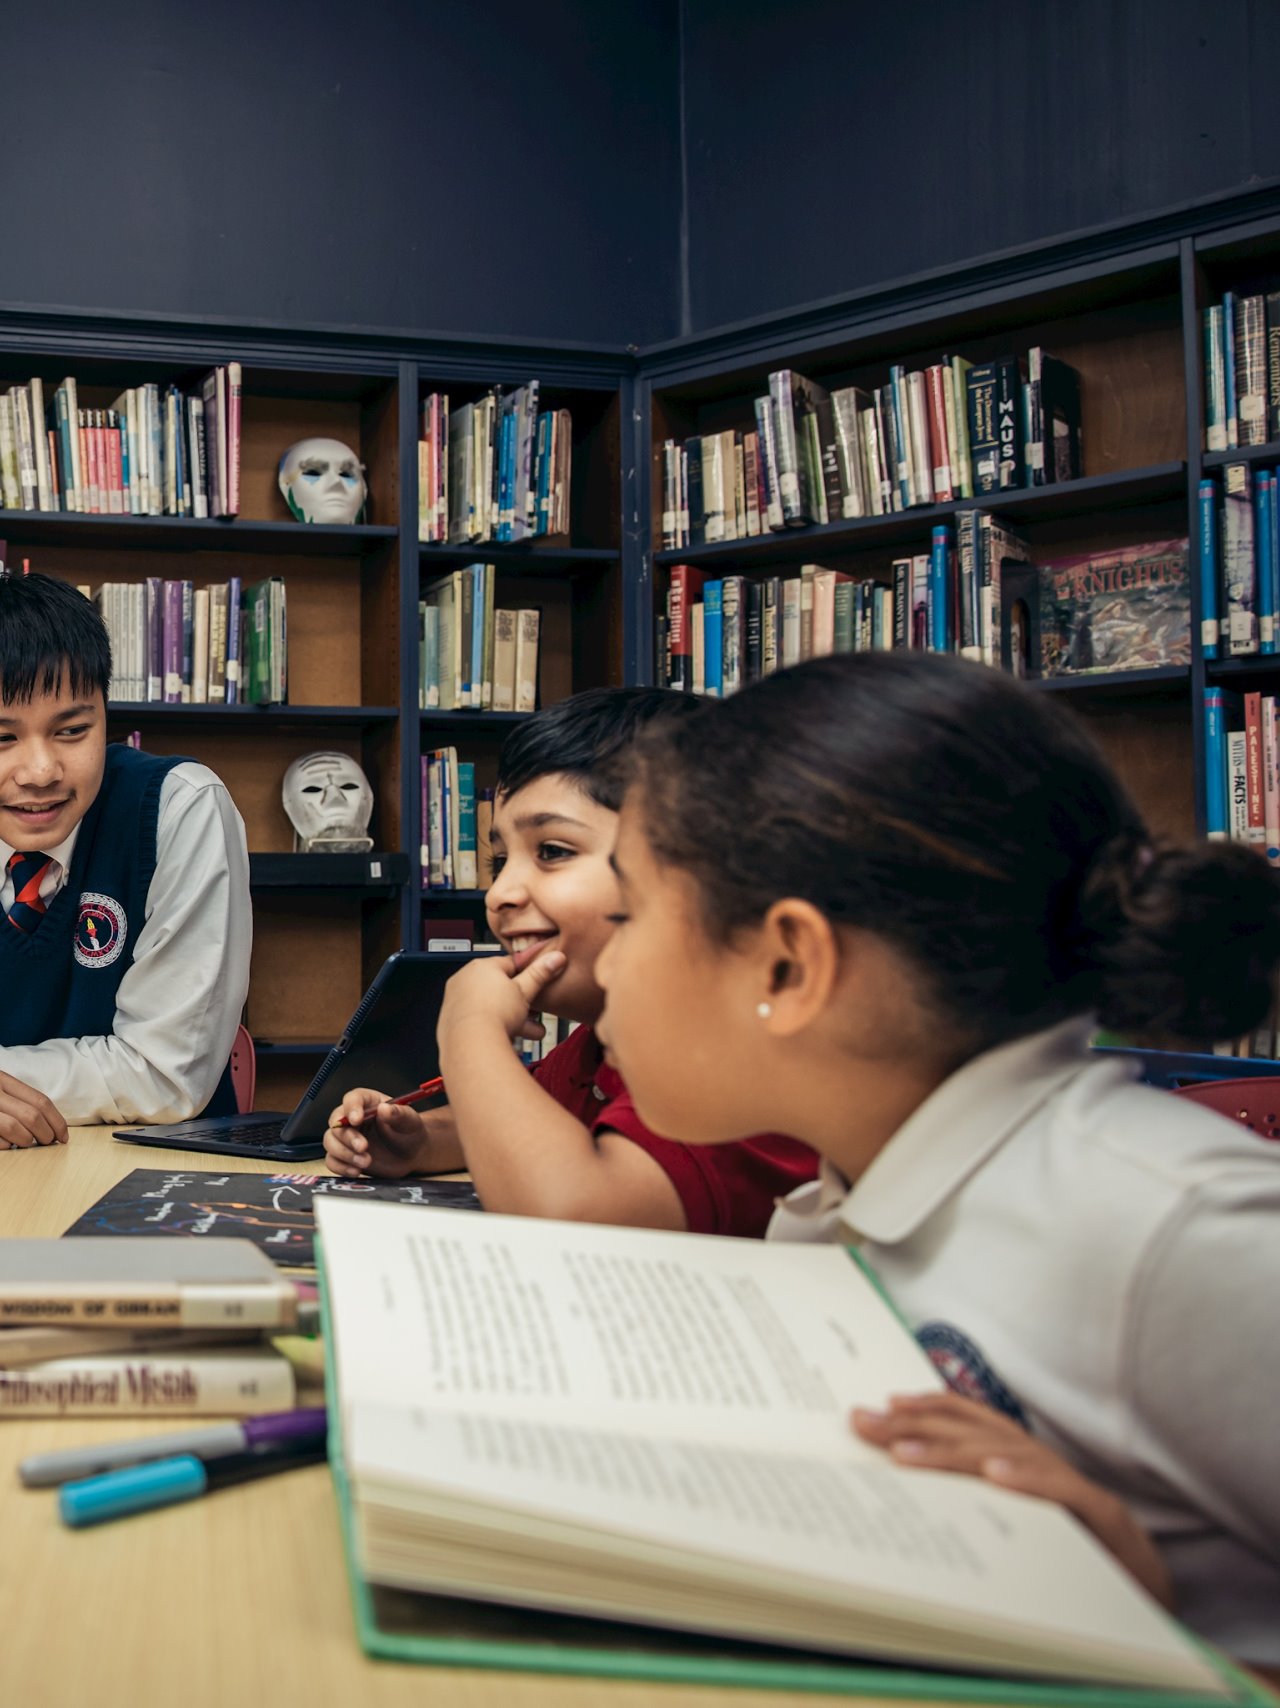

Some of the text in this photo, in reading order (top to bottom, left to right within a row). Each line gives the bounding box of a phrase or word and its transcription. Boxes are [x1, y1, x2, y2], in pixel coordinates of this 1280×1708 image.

[1268, 327, 1280, 405] Remembers
[998, 399, 1015, 458] MAUS
[1073, 559, 1185, 602] KNIGHTS
[1232, 739, 1243, 767] MYTHS
[1249, 725, 1259, 813] PALESTINE
[1235, 775, 1247, 804] FACTS
[0, 1301, 75, 1317] WISDOM
[82, 1301, 107, 1317] OF
[124, 1361, 198, 1410] Mistak
